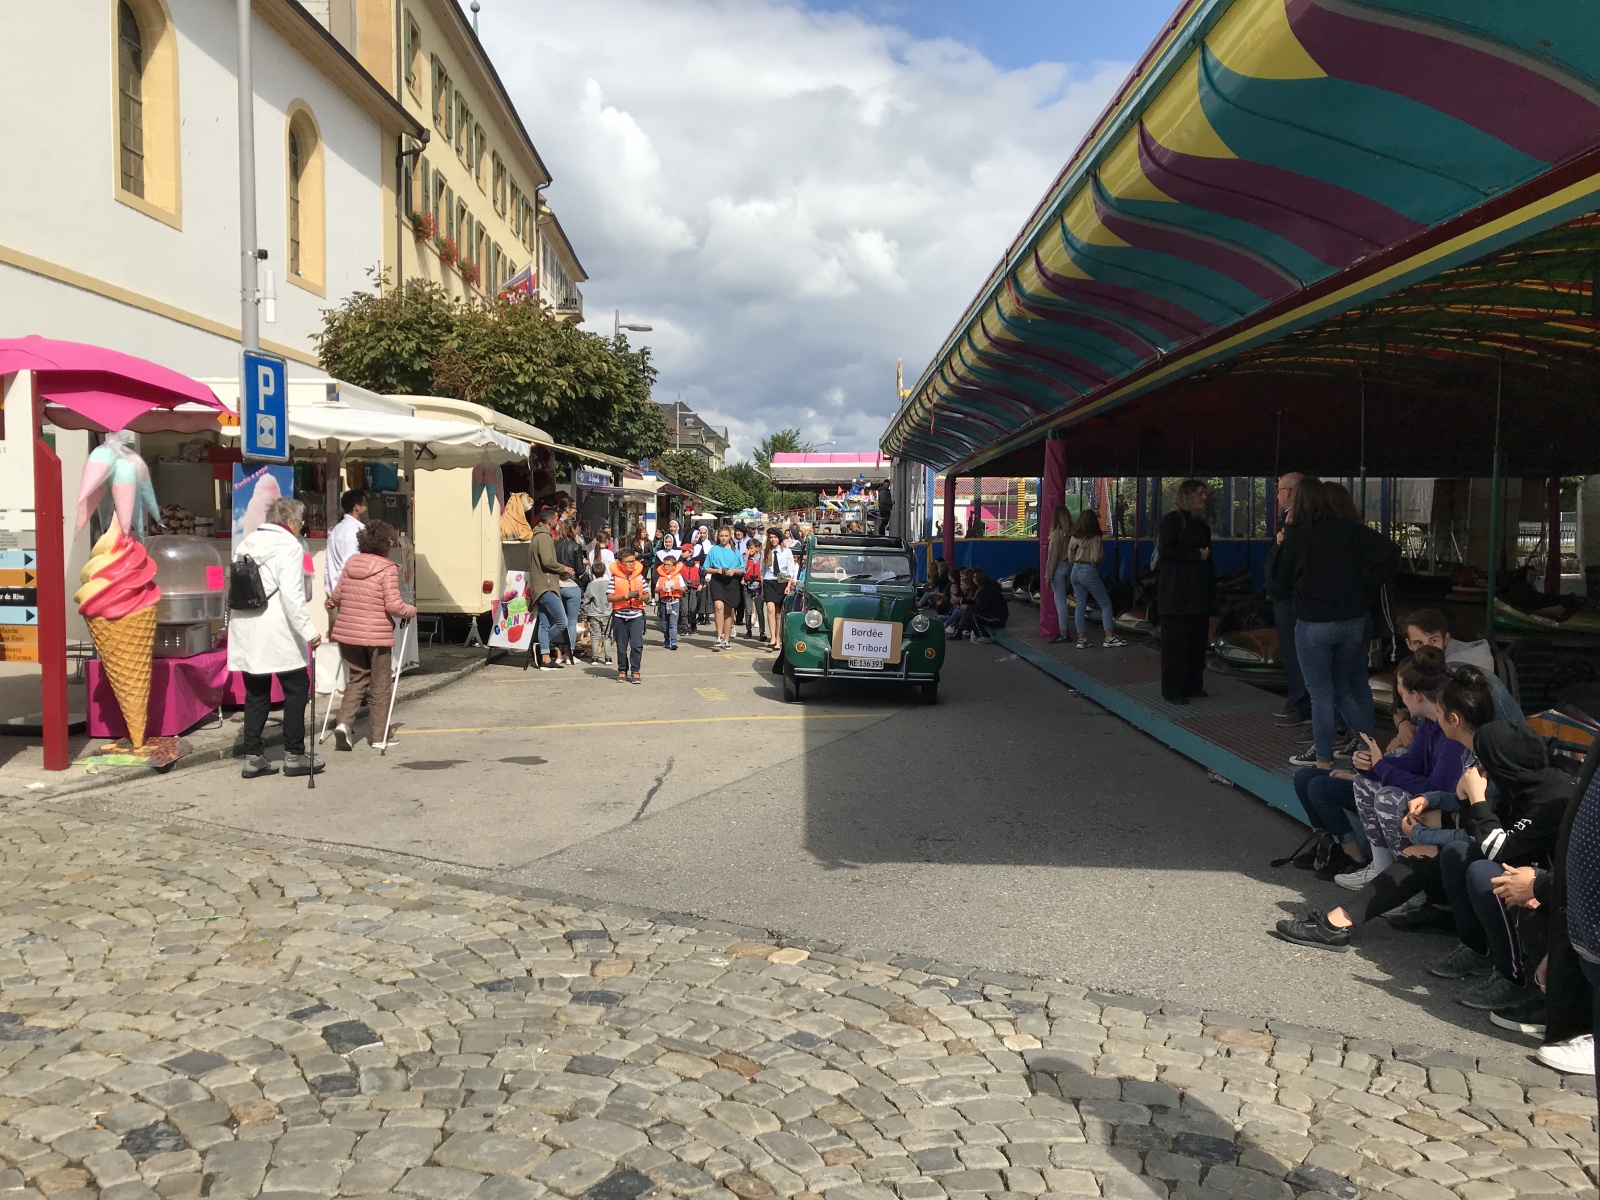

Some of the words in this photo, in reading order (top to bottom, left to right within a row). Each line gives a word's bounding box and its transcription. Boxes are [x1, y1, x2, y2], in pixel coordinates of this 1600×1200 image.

[258, 365, 274, 410] P
[494, 612, 534, 635] GRANITA
[851, 628, 883, 638] Bordée
[844, 643, 855, 651] de
[857, 643, 888, 653] Tribord
[849, 659, 858, 667] NE
